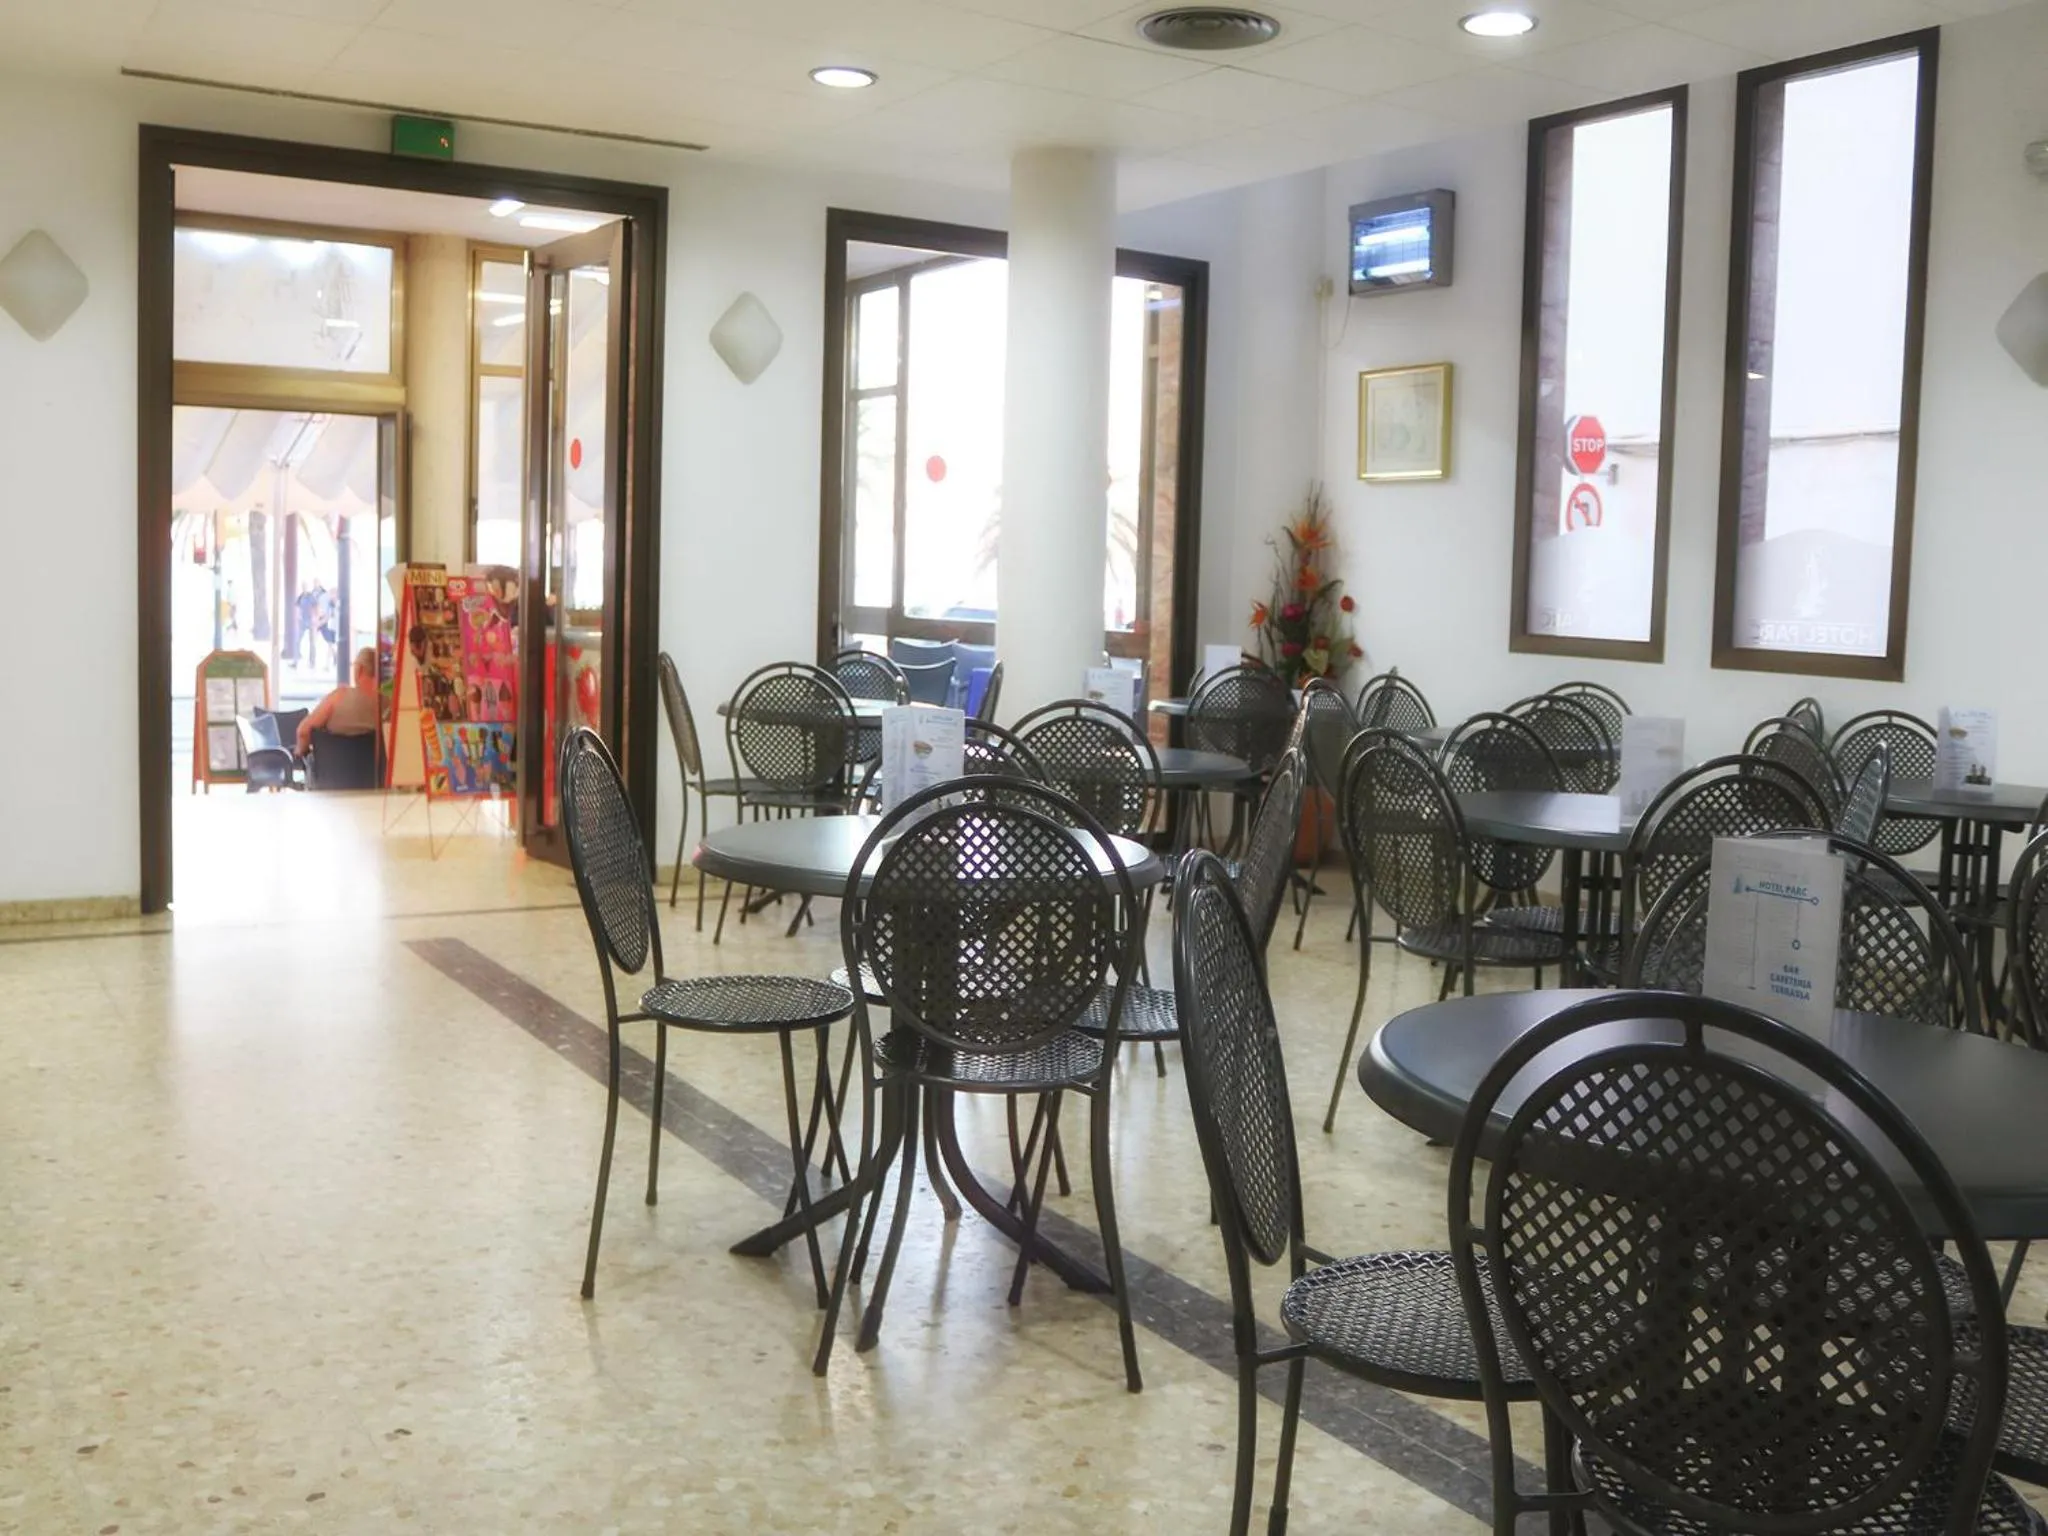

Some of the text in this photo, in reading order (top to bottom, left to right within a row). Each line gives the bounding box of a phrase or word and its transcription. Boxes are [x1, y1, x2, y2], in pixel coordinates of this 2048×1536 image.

[1573, 438, 1605, 453] STOP
[411, 570, 443, 584] MINI
[1759, 881, 1807, 896] HOTEL PARC
[1783, 964, 1799, 975] BAR
[1771, 985, 1810, 1000] TERRASSA
